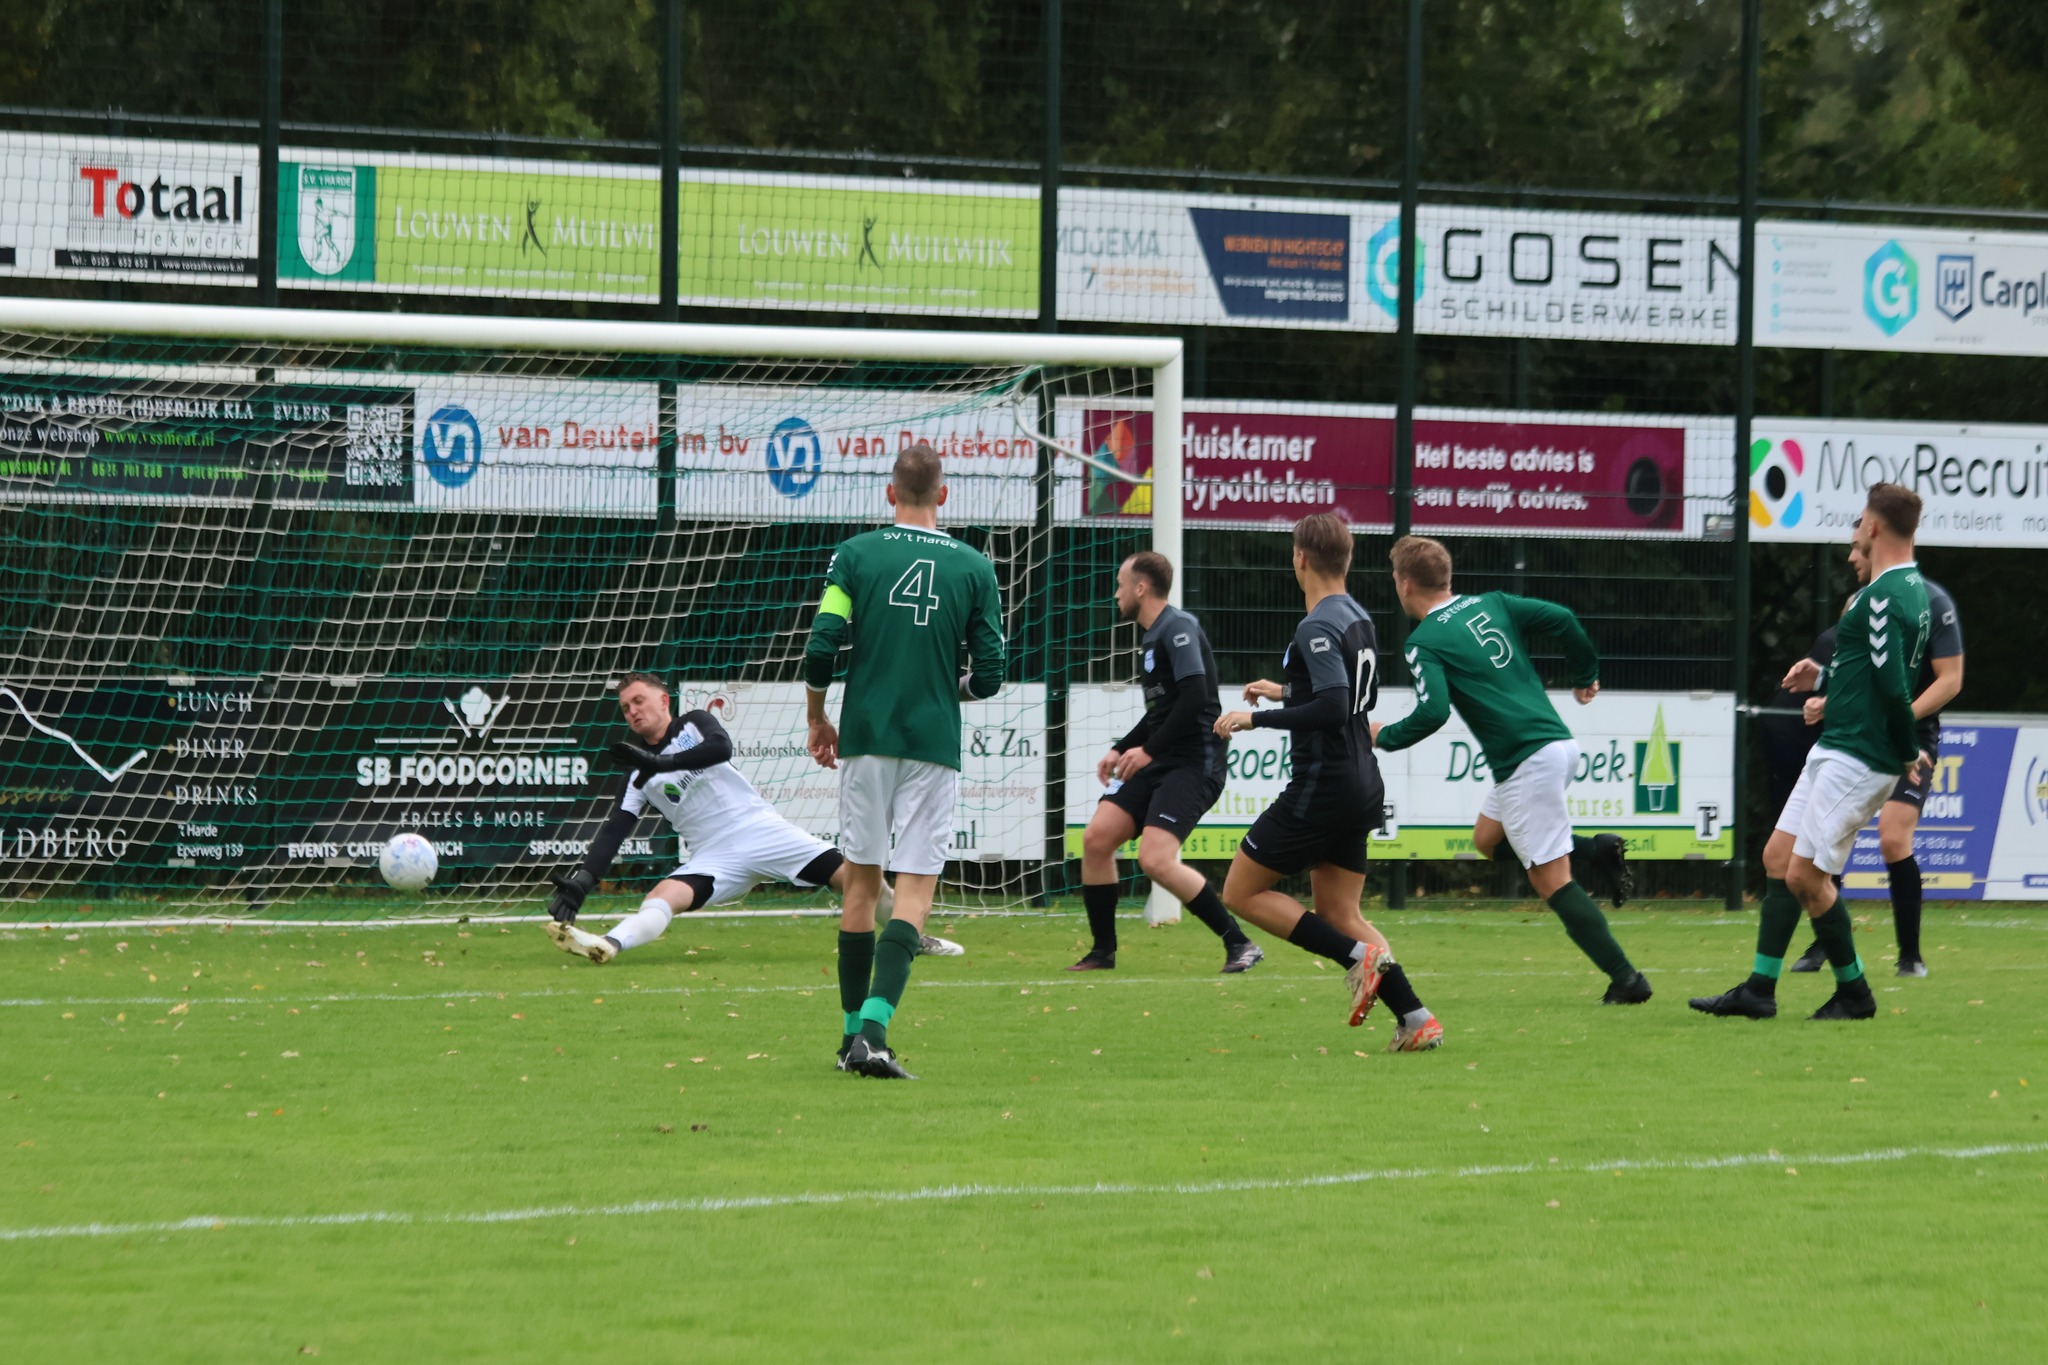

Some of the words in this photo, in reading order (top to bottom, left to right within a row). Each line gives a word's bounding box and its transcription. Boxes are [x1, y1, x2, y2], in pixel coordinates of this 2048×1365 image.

[80, 166, 243, 223] Totaal
[134, 228, 243, 250] Hekwerk
[395, 205, 511, 242] LOUWEN
[552, 214, 655, 250] MUILWI
[738, 223, 850, 258] LOUWEN
[888, 231, 1013, 269] MUILWIJK
[1442, 227, 1739, 294] GOSEN
[1980, 271, 2048, 318] Carpl
[36, 425, 100, 448] webshop
[498, 424, 551, 450] van
[719, 424, 751, 457] bv
[837, 434, 885, 460] van
[1415, 442, 1450, 469] Het
[1453, 443, 1507, 471] beste
[1510, 445, 1574, 473] advies
[1578, 447, 1595, 473] is
[1518, 483, 1588, 511] advies.
[1952, 509, 2004, 532] talent
[2022, 516, 2048, 532] ma
[882, 532, 902, 540] SV
[916, 534, 959, 549] Harde
[888, 558, 940, 626] 4
[1436, 609, 1452, 624] SV
[1465, 611, 1514, 669] 5
[176, 690, 254, 713] LUNCH
[175, 737, 246, 759] DINER
[970, 728, 990, 757] &
[1001, 728, 1039, 758] Zn.
[356, 755, 391, 787] SB
[399, 756, 590, 786] FOODCORNER
[174, 784, 258, 806] DRINKS
[186, 823, 219, 838] Harde
[399, 810, 464, 829] FRITES
[473, 810, 483, 829] &
[494, 810, 546, 828] MORE
[176, 842, 223, 860] Eperweg
[287, 842, 339, 859] EVENTS
